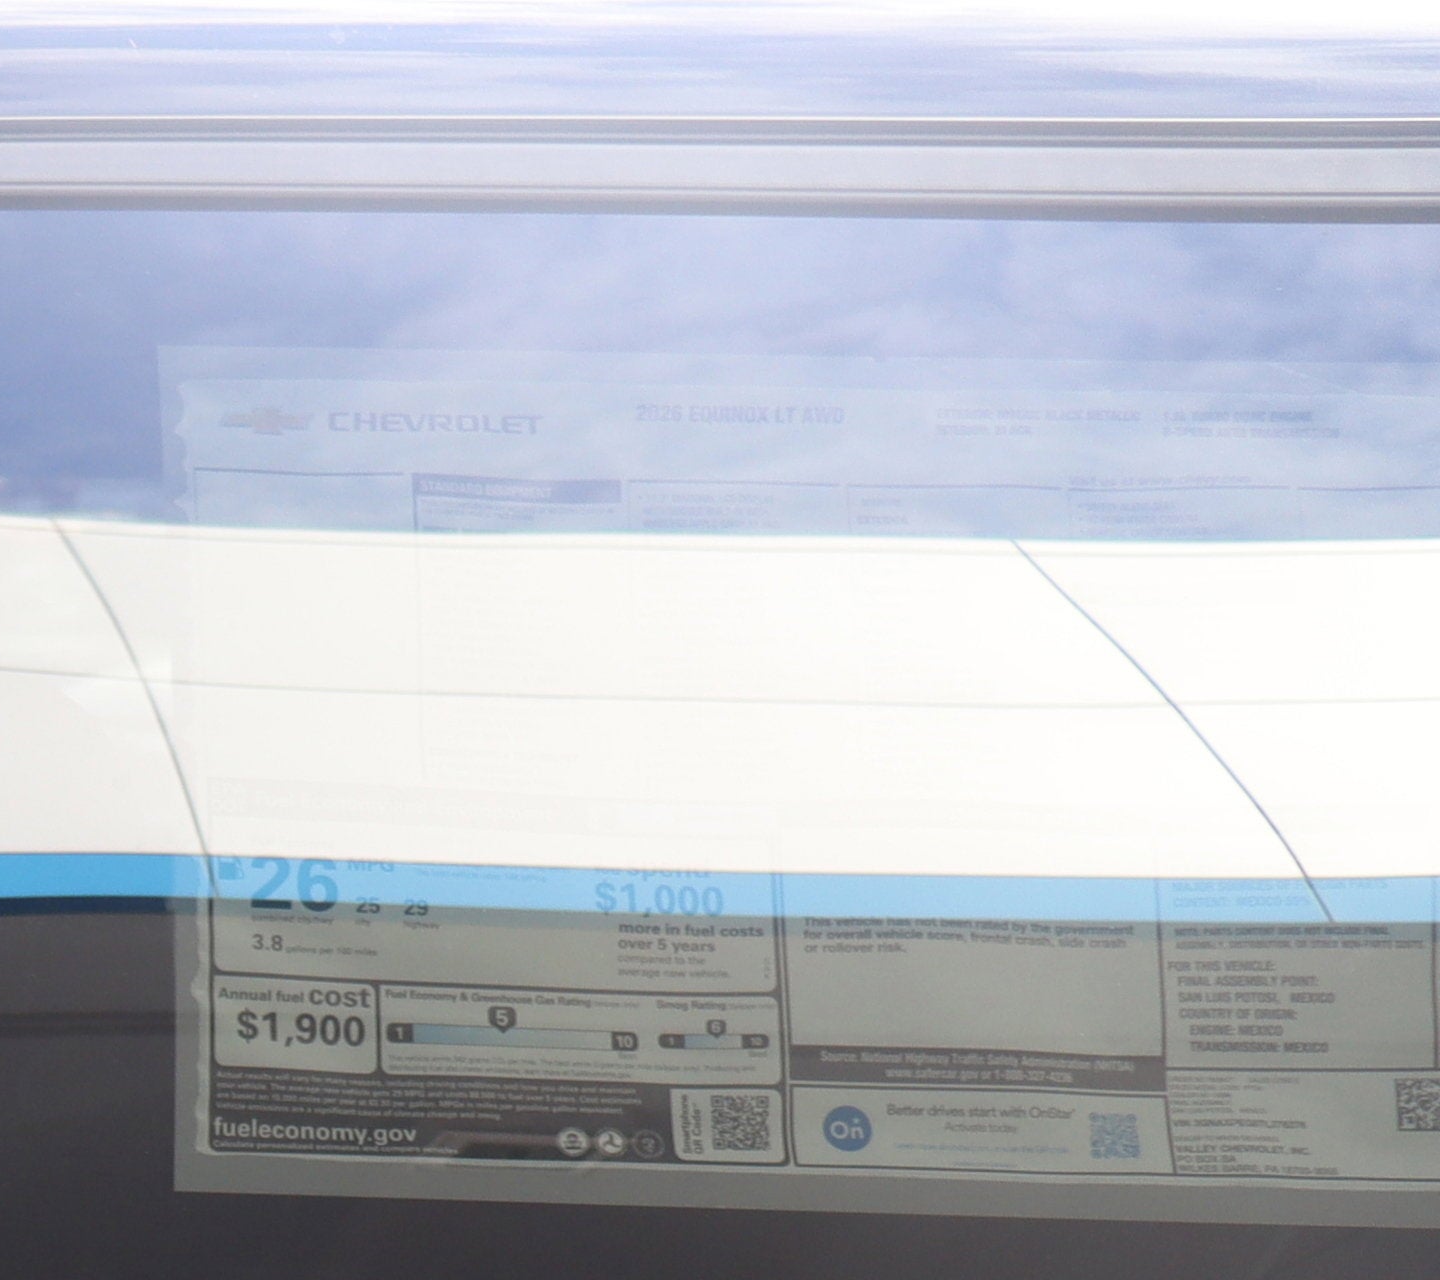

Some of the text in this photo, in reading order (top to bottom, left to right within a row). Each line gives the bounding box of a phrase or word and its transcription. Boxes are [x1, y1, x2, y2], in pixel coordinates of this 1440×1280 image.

[635, 404, 846, 425] 2026 EQUINOX LT AWD
[329, 411, 544, 435] CHEVROLET
[251, 857, 338, 912] 26
[595, 880, 724, 918] $1,000
[356, 897, 429, 917] 25 29
[618, 923, 764, 937] more in fuel costs
[804, 916, 1134, 936] This vehicle has not been rated by the government
[251, 933, 284, 952] 3.8
[617, 938, 715, 953] over 5 years
[803, 929, 1126, 948] for overall vehicle score, frontal crash, side crash
[285, 945, 378, 956] gallons per 100 miles
[804, 943, 907, 953] or rollover risk.
[617, 955, 705, 966] compared to the
[1167, 961, 1276, 971] FOR THIS VEHICLE:
[618, 969, 730, 979] average new vehicle.
[1177, 975, 1319, 986] FINAL ASSEMBLY POINT:
[218, 987, 370, 1008] Annual fuel cost
[385, 989, 591, 1008] Fuel Economy & Greenhouse Gas Rating
[1178, 992, 1202, 1003] SAN
[1205, 992, 1231, 1003] LUIS
[1289, 992, 1335, 1003] MEXICO
[656, 999, 726, 1012] Smog Rating
[495, 1009, 509, 1025] 5
[1178, 1008, 1298, 1020] COUNTRY OF ORIGIN:
[237, 1007, 365, 1047] $1,900
[711, 1021, 721, 1033] 6
[1189, 1024, 1284, 1036] ENGINE: MEXICO
[396, 1026, 634, 1048] 1 10
[1189, 1041, 1329, 1053] TRANSMISSION: MEXICO
[861, 1052, 903, 1063] National
[905, 1052, 949, 1067] Highway
[951, 1053, 985, 1065] Traffic
[987, 1054, 1019, 1067] Safety
[886, 1103, 926, 1117] Better
[929, 1105, 965, 1117] drives
[968, 1106, 995, 1118] start
[999, 1106, 1027, 1119] with
[213, 1116, 417, 1145] fueleconomy.gov
[944, 1122, 1019, 1135] Activate today
[213, 1139, 254, 1149] Calculate
[257, 1140, 314, 1152] personalized
[316, 1143, 361, 1152] estimates
[362, 1144, 379, 1152] and
[380, 1145, 420, 1155] compare
[1175, 1145, 1216, 1153] VALLEY
